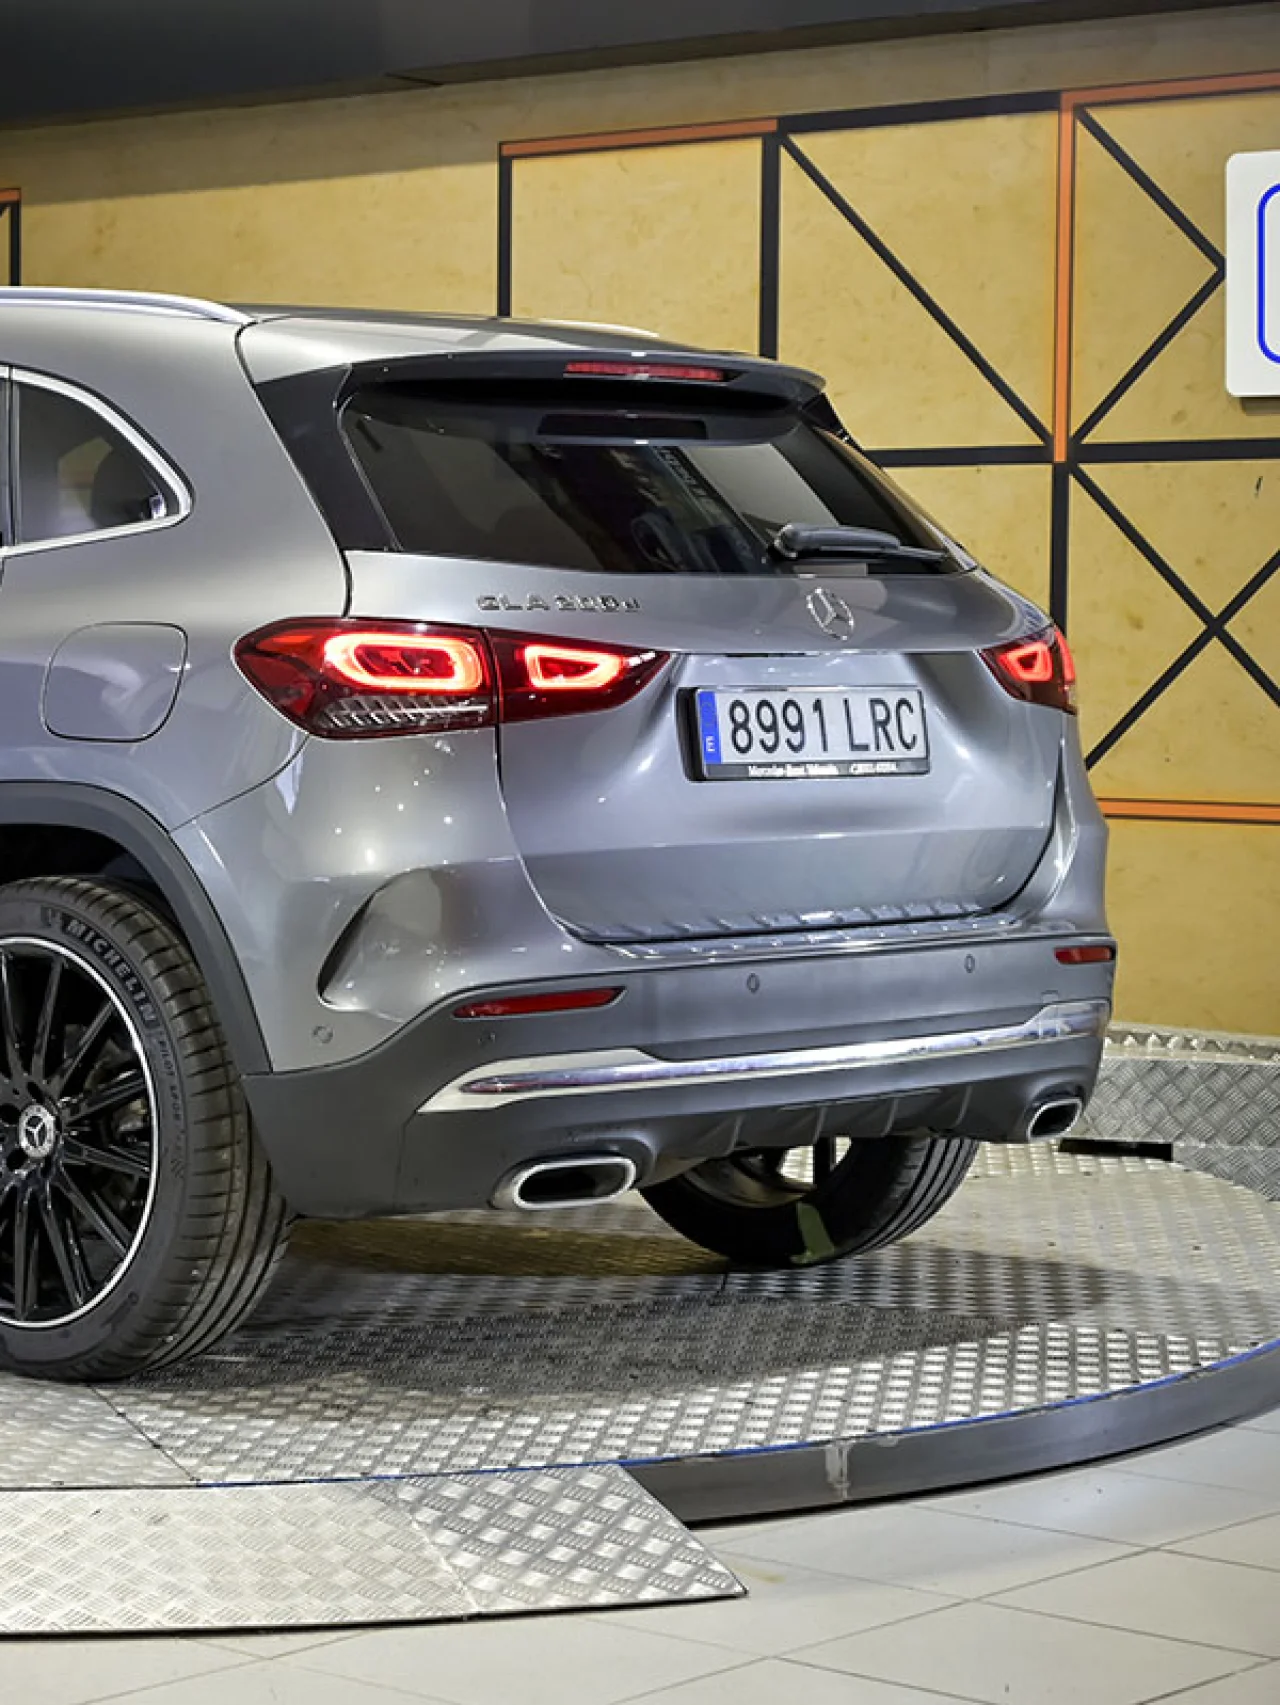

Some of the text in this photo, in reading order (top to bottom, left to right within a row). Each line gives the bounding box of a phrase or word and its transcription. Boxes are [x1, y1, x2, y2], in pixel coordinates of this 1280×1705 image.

[477, 593, 550, 611] GLA
[706, 735, 716, 752] E
[729, 697, 918, 753] 8991 LRC
[66, 918, 158, 1022] MICHELIN
